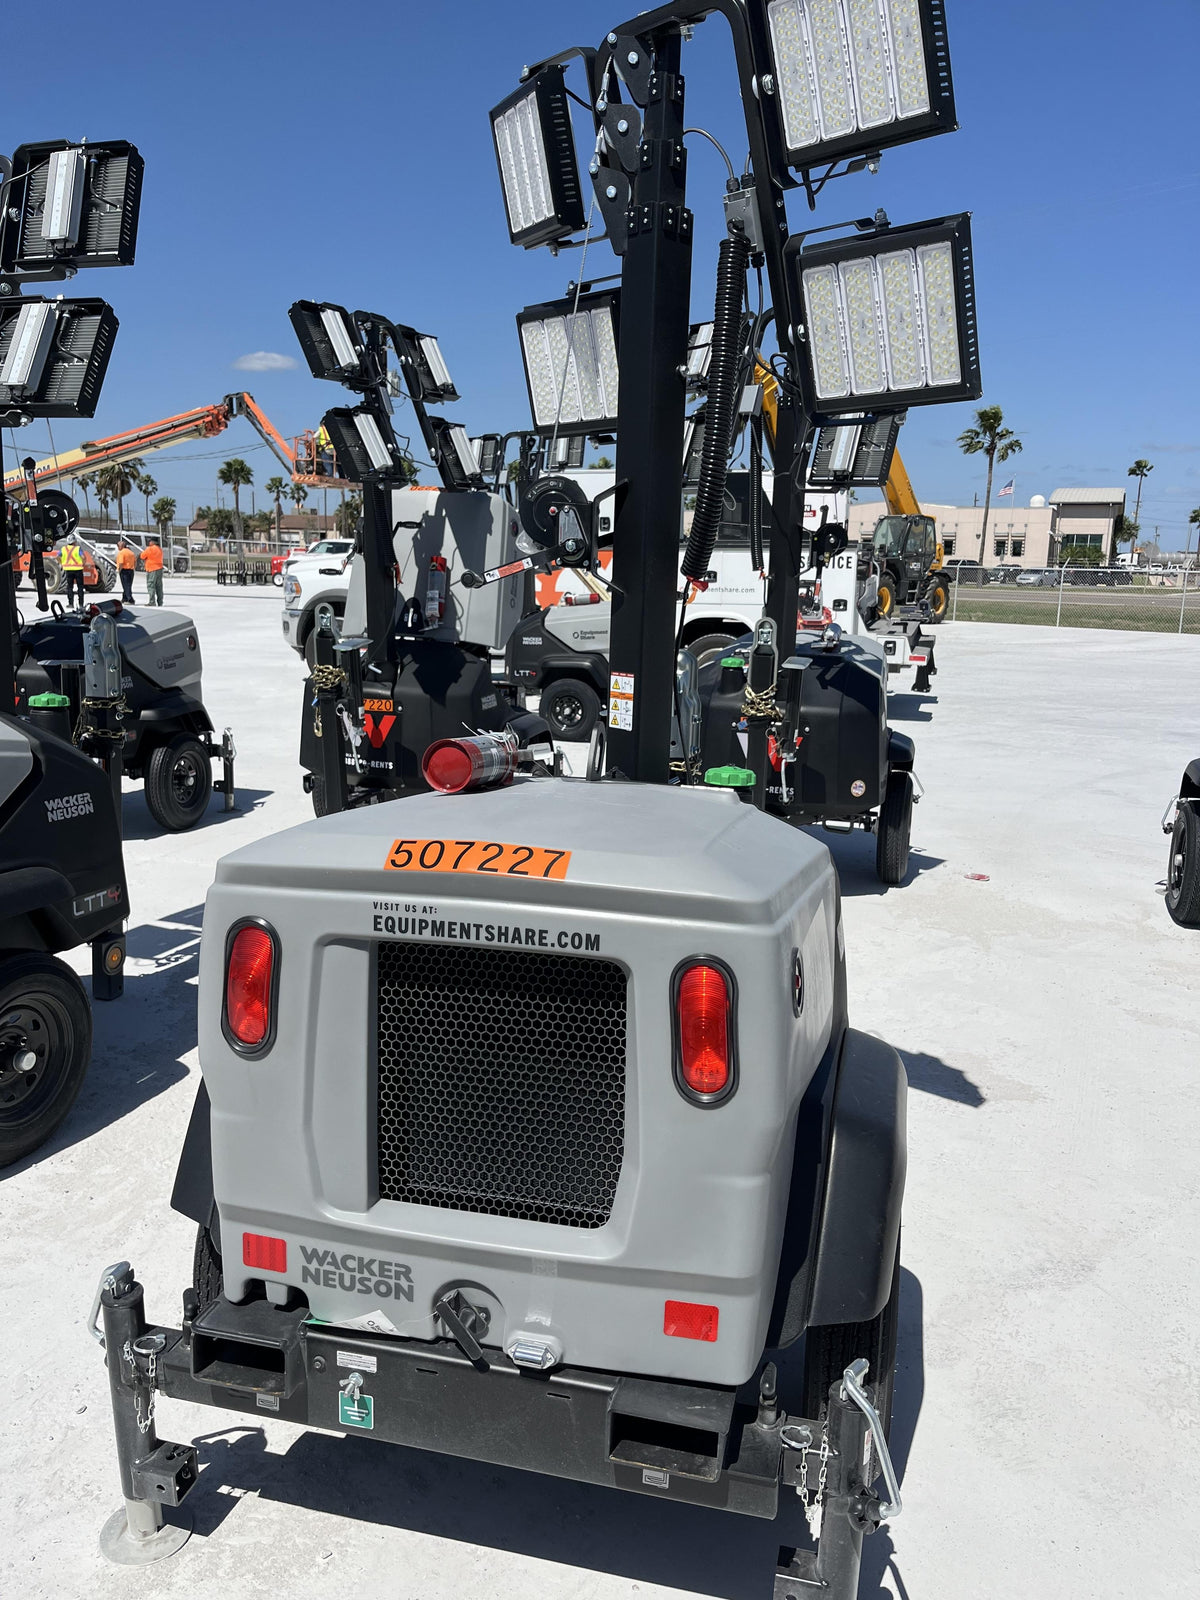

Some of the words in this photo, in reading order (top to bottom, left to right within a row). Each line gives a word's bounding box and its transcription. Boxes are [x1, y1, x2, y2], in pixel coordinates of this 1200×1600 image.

[44, 792, 92, 811] WACKER
[47, 802, 94, 822] NEUSON
[390, 840, 566, 878] 507227
[73, 889, 120, 916] LTT4
[373, 901, 400, 912] VISIT
[405, 903, 417, 914] US
[422, 905, 438, 915] AT:
[373, 914, 601, 952] EQUIPMENTSHARE.COM
[299, 1245, 414, 1283] WACKER
[301, 1265, 414, 1303] NEUSON
